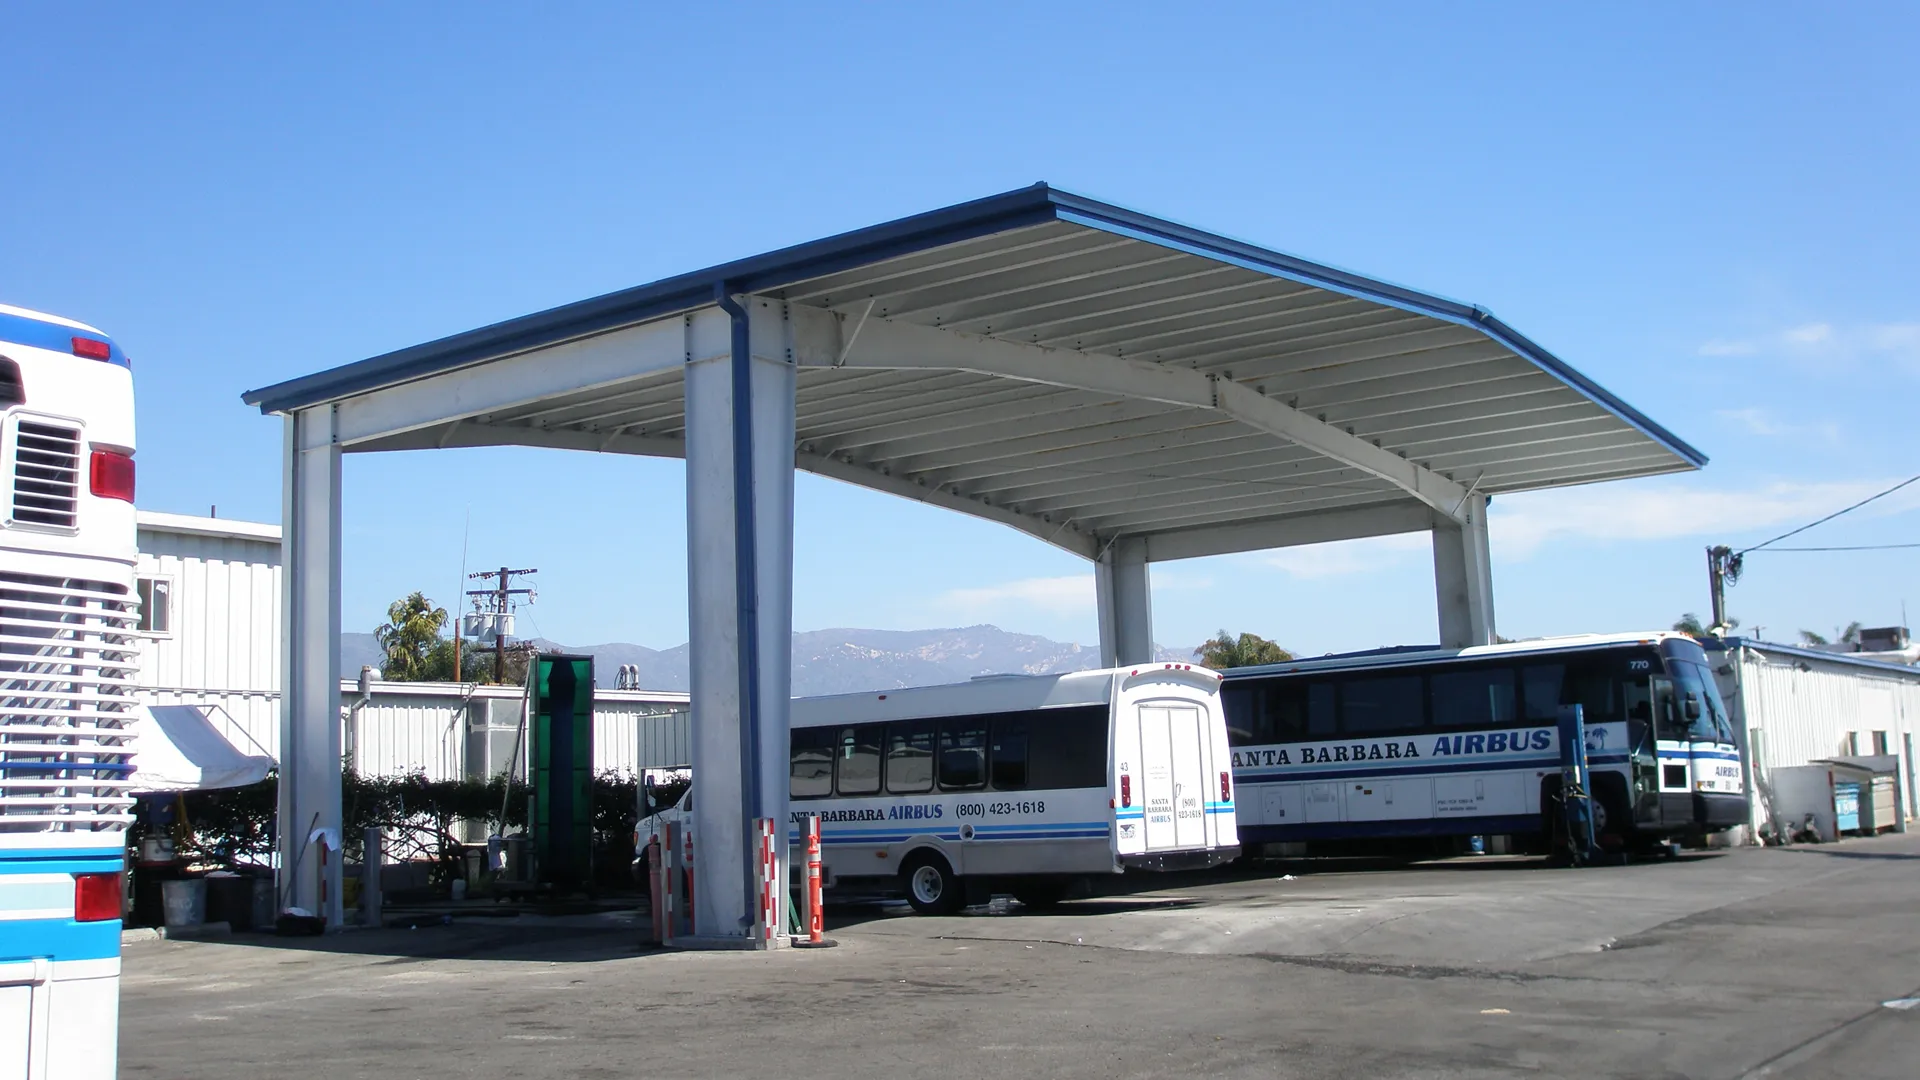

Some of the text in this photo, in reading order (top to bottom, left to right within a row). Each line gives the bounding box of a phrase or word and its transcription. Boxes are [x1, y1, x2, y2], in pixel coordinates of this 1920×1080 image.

[1630, 660, 1649, 669] 770
[1300, 741, 1420, 764] BARBARA
[1432, 729, 1551, 757] AIRBUS
[1120, 762, 1129, 772] 43
[1715, 765, 1739, 778] AIRBUS
[1182, 798, 1196, 808] (800)
[820, 808, 885, 823] BARBARA
[888, 804, 943, 820] AIRBUS
[955, 803, 985, 819] (800)
[989, 801, 1045, 815] 423-1618
[1178, 810, 1202, 819] 423-1618
[1150, 815, 1171, 823] AIRBUS
